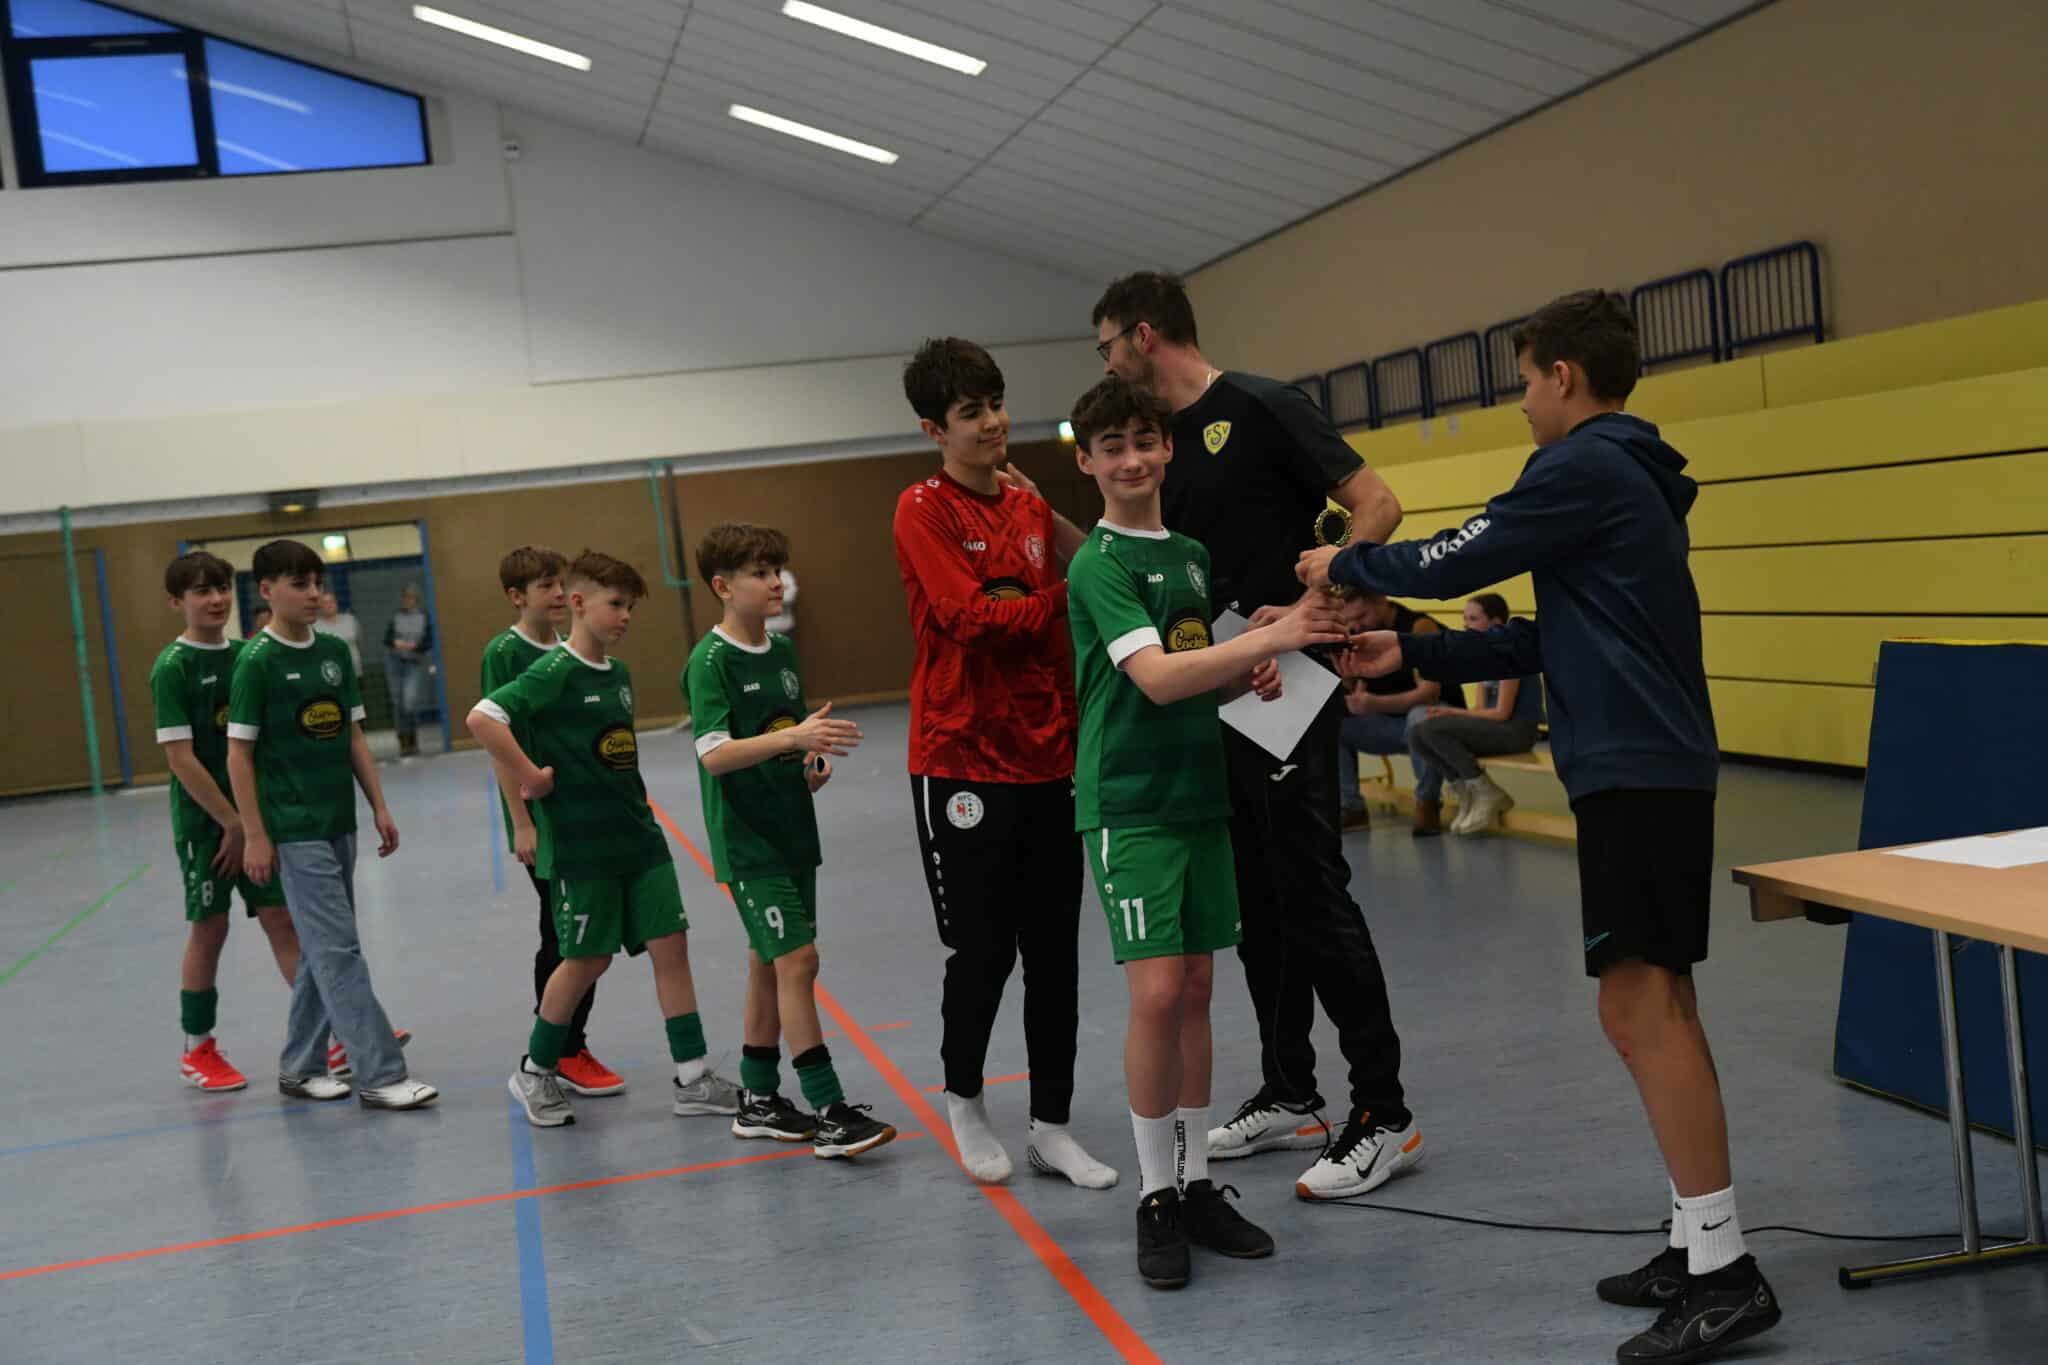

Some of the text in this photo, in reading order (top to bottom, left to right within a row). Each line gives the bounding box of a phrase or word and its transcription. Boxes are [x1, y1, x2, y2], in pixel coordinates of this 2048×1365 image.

[201, 880, 214, 907] 8
[573, 913, 590, 945] 7
[765, 905, 784, 939] 9
[1119, 897, 1146, 941] 11
